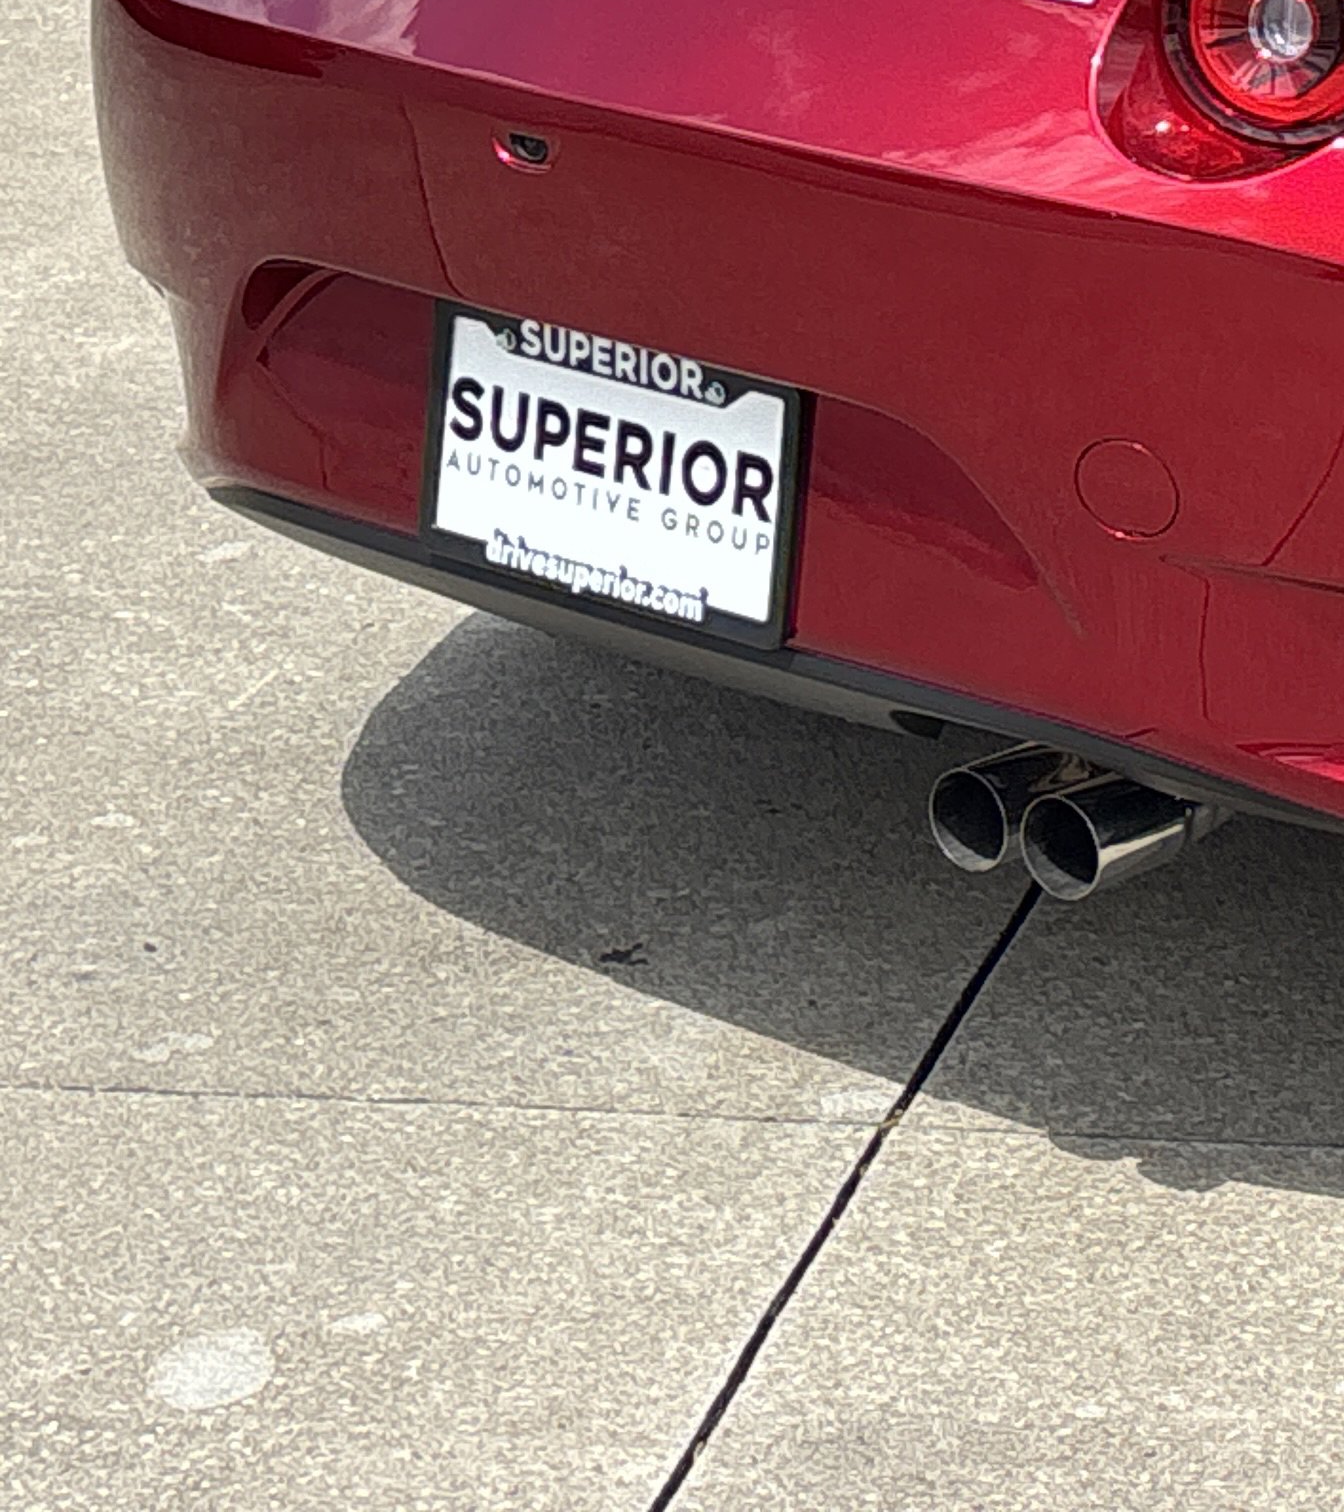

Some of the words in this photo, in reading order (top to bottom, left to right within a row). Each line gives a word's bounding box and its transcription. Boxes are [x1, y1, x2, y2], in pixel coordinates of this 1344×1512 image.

[519, 317, 704, 401] SUPERIOR
[446, 448, 641, 522] AUTOMOTIVE
[661, 508, 772, 556] GROUP
[449, 376, 775, 524] SUPERIOR
